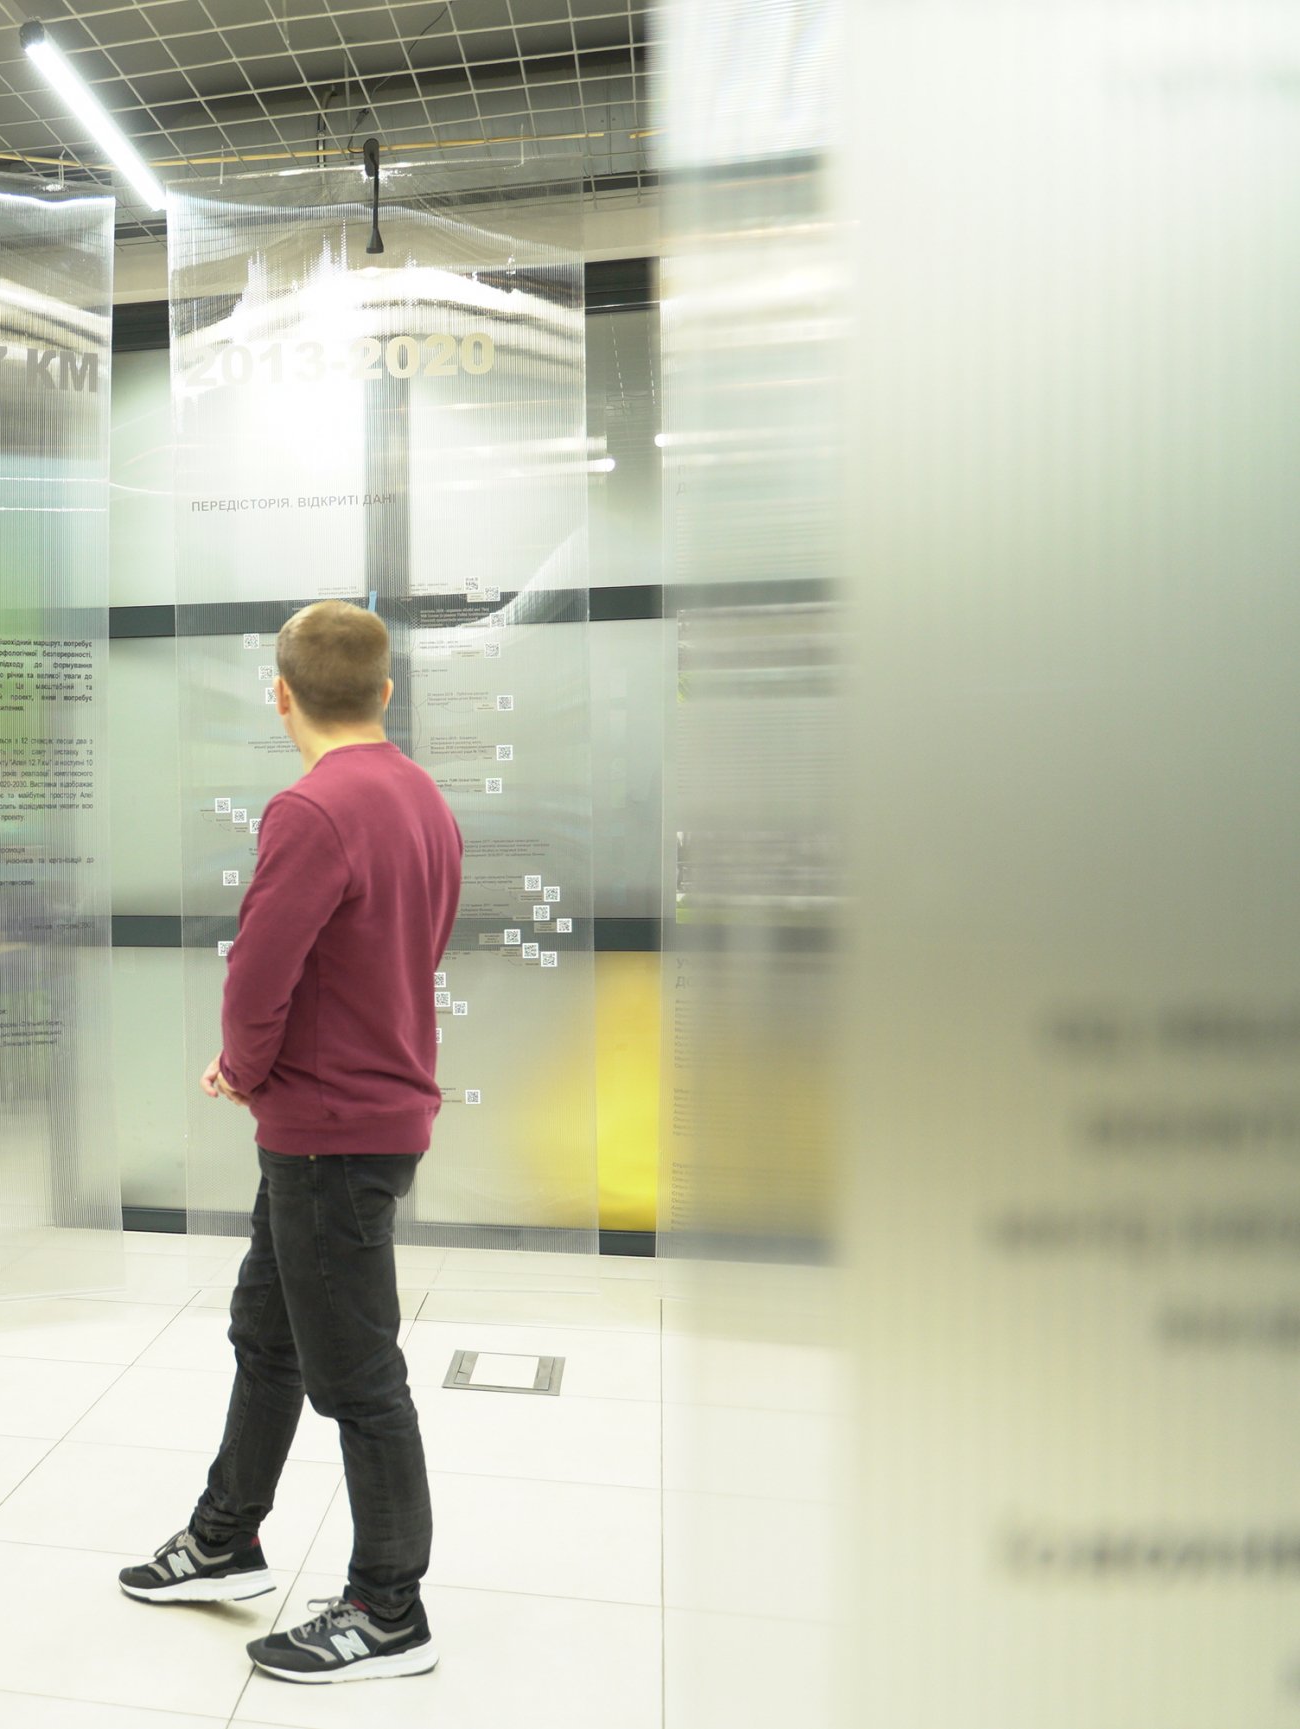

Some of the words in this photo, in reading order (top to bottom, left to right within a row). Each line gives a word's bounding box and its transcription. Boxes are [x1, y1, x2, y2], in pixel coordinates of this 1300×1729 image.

[185, 331, 495, 387] 2013-2020
[25, 348, 98, 393] КМ
[191, 498, 293, 512] ПЕРЕДІСТОРІЯ.
[297, 494, 359, 509] ВІДКРИТІ
[362, 493, 396, 506] ДАНІ
[63, 640, 92, 648] потребує
[0, 661, 24, 669] підходу
